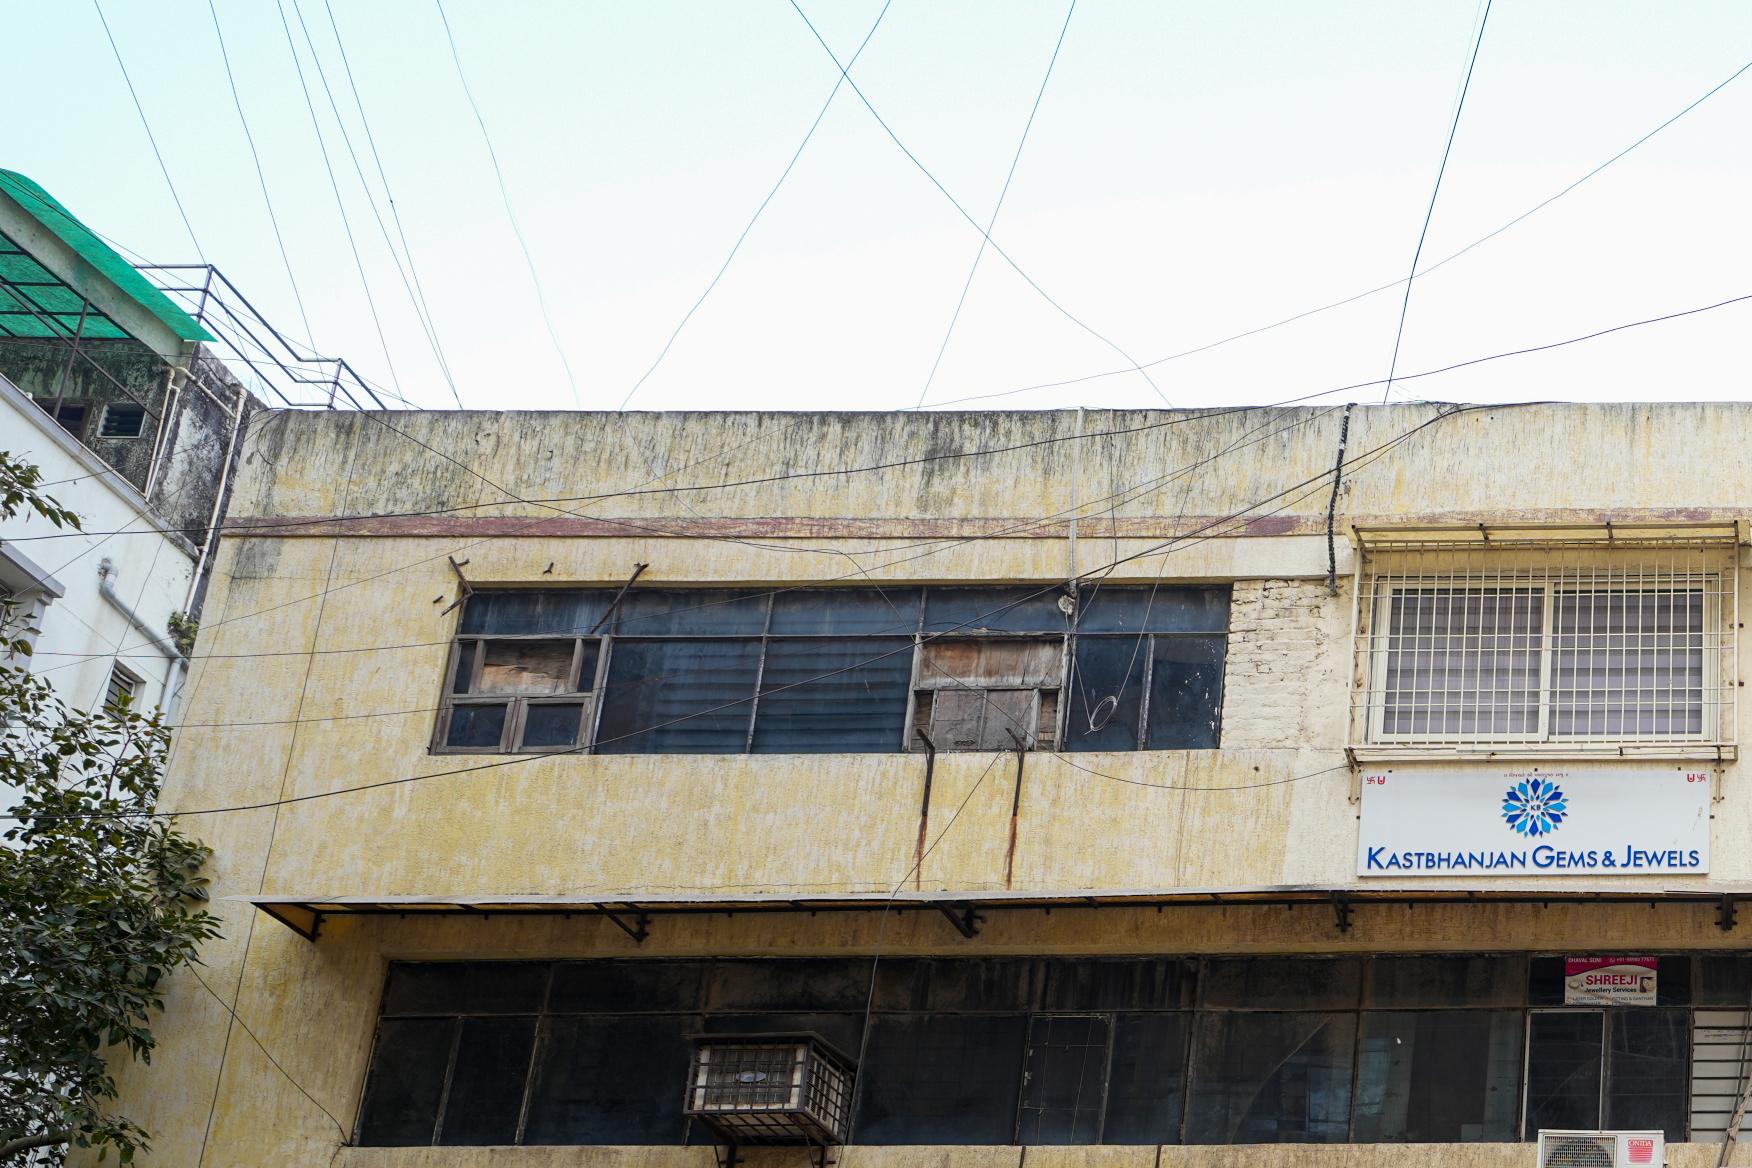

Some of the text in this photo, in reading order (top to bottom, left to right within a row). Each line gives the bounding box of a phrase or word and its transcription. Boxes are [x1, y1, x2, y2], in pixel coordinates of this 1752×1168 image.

[1367, 844, 1700, 870] KASTBHANJAN GEMS & JEWELS
[1586, 975, 1637, 985] SHREEJI
